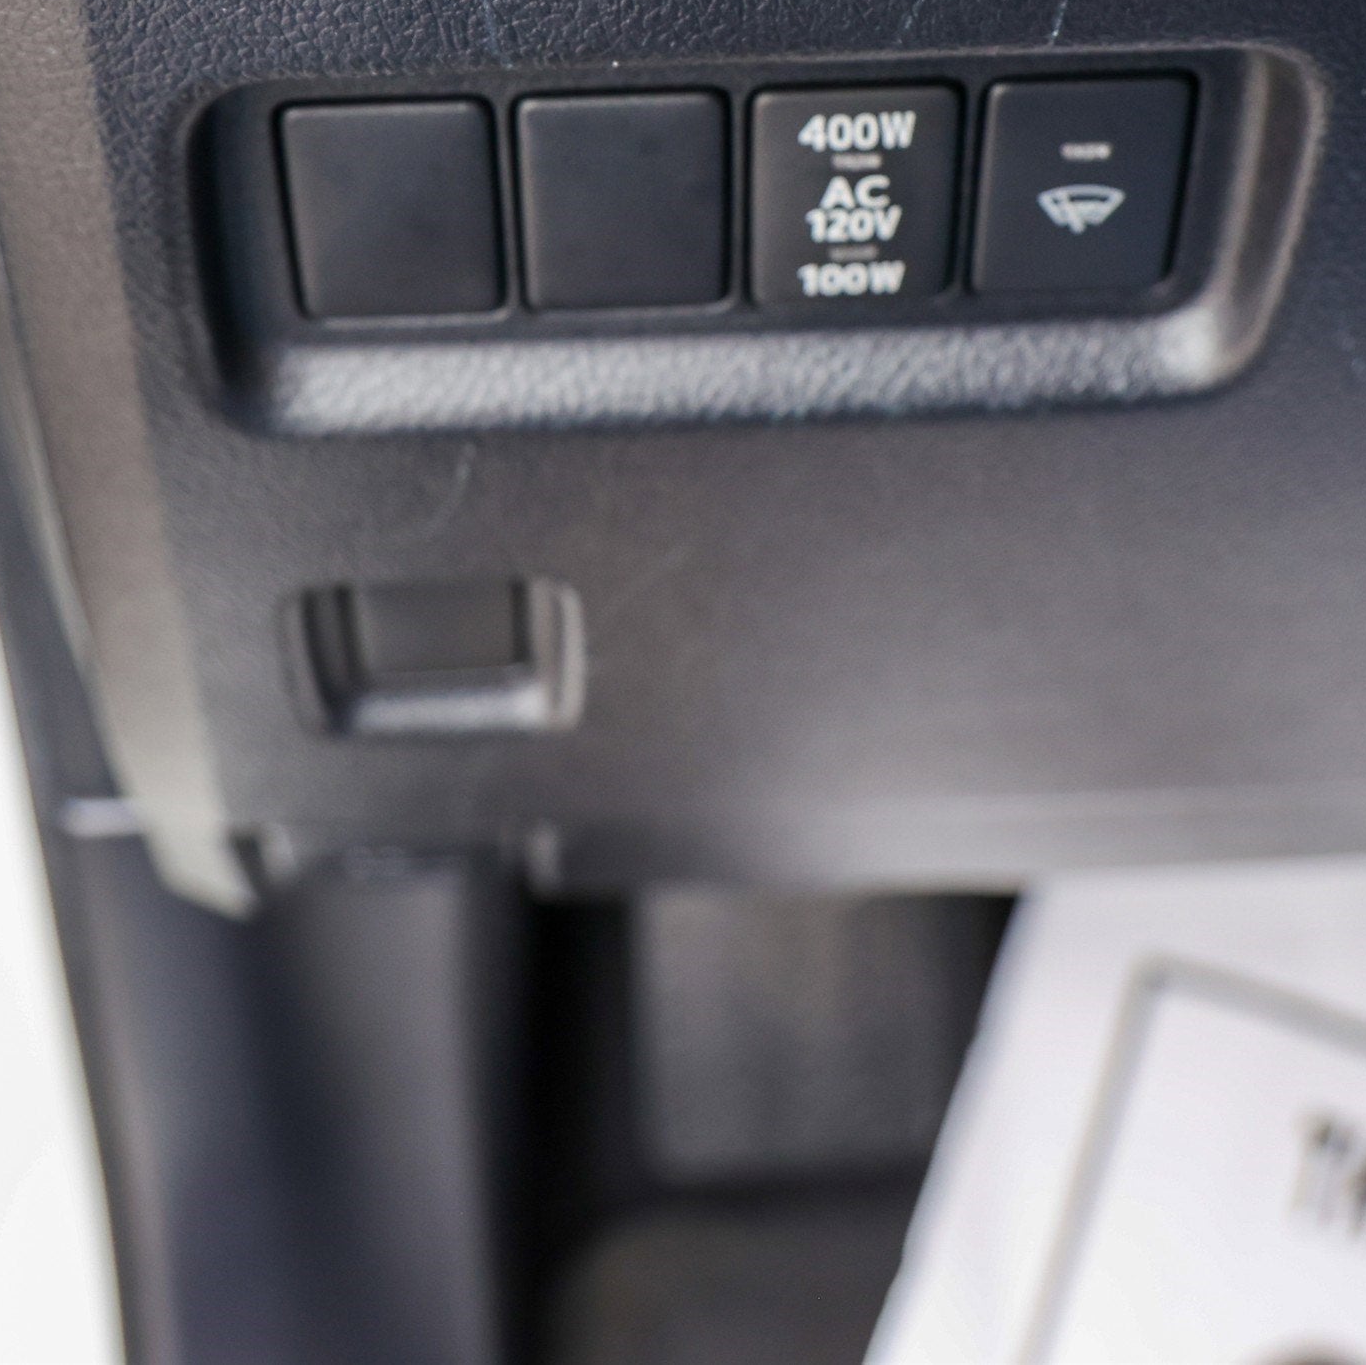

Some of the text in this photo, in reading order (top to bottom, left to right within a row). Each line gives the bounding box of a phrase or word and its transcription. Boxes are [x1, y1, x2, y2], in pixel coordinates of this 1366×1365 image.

[797, 110, 917, 153] 400W
[819, 174, 891, 210] AC
[805, 204, 903, 243] 120V
[796, 259, 907, 297] 100W
